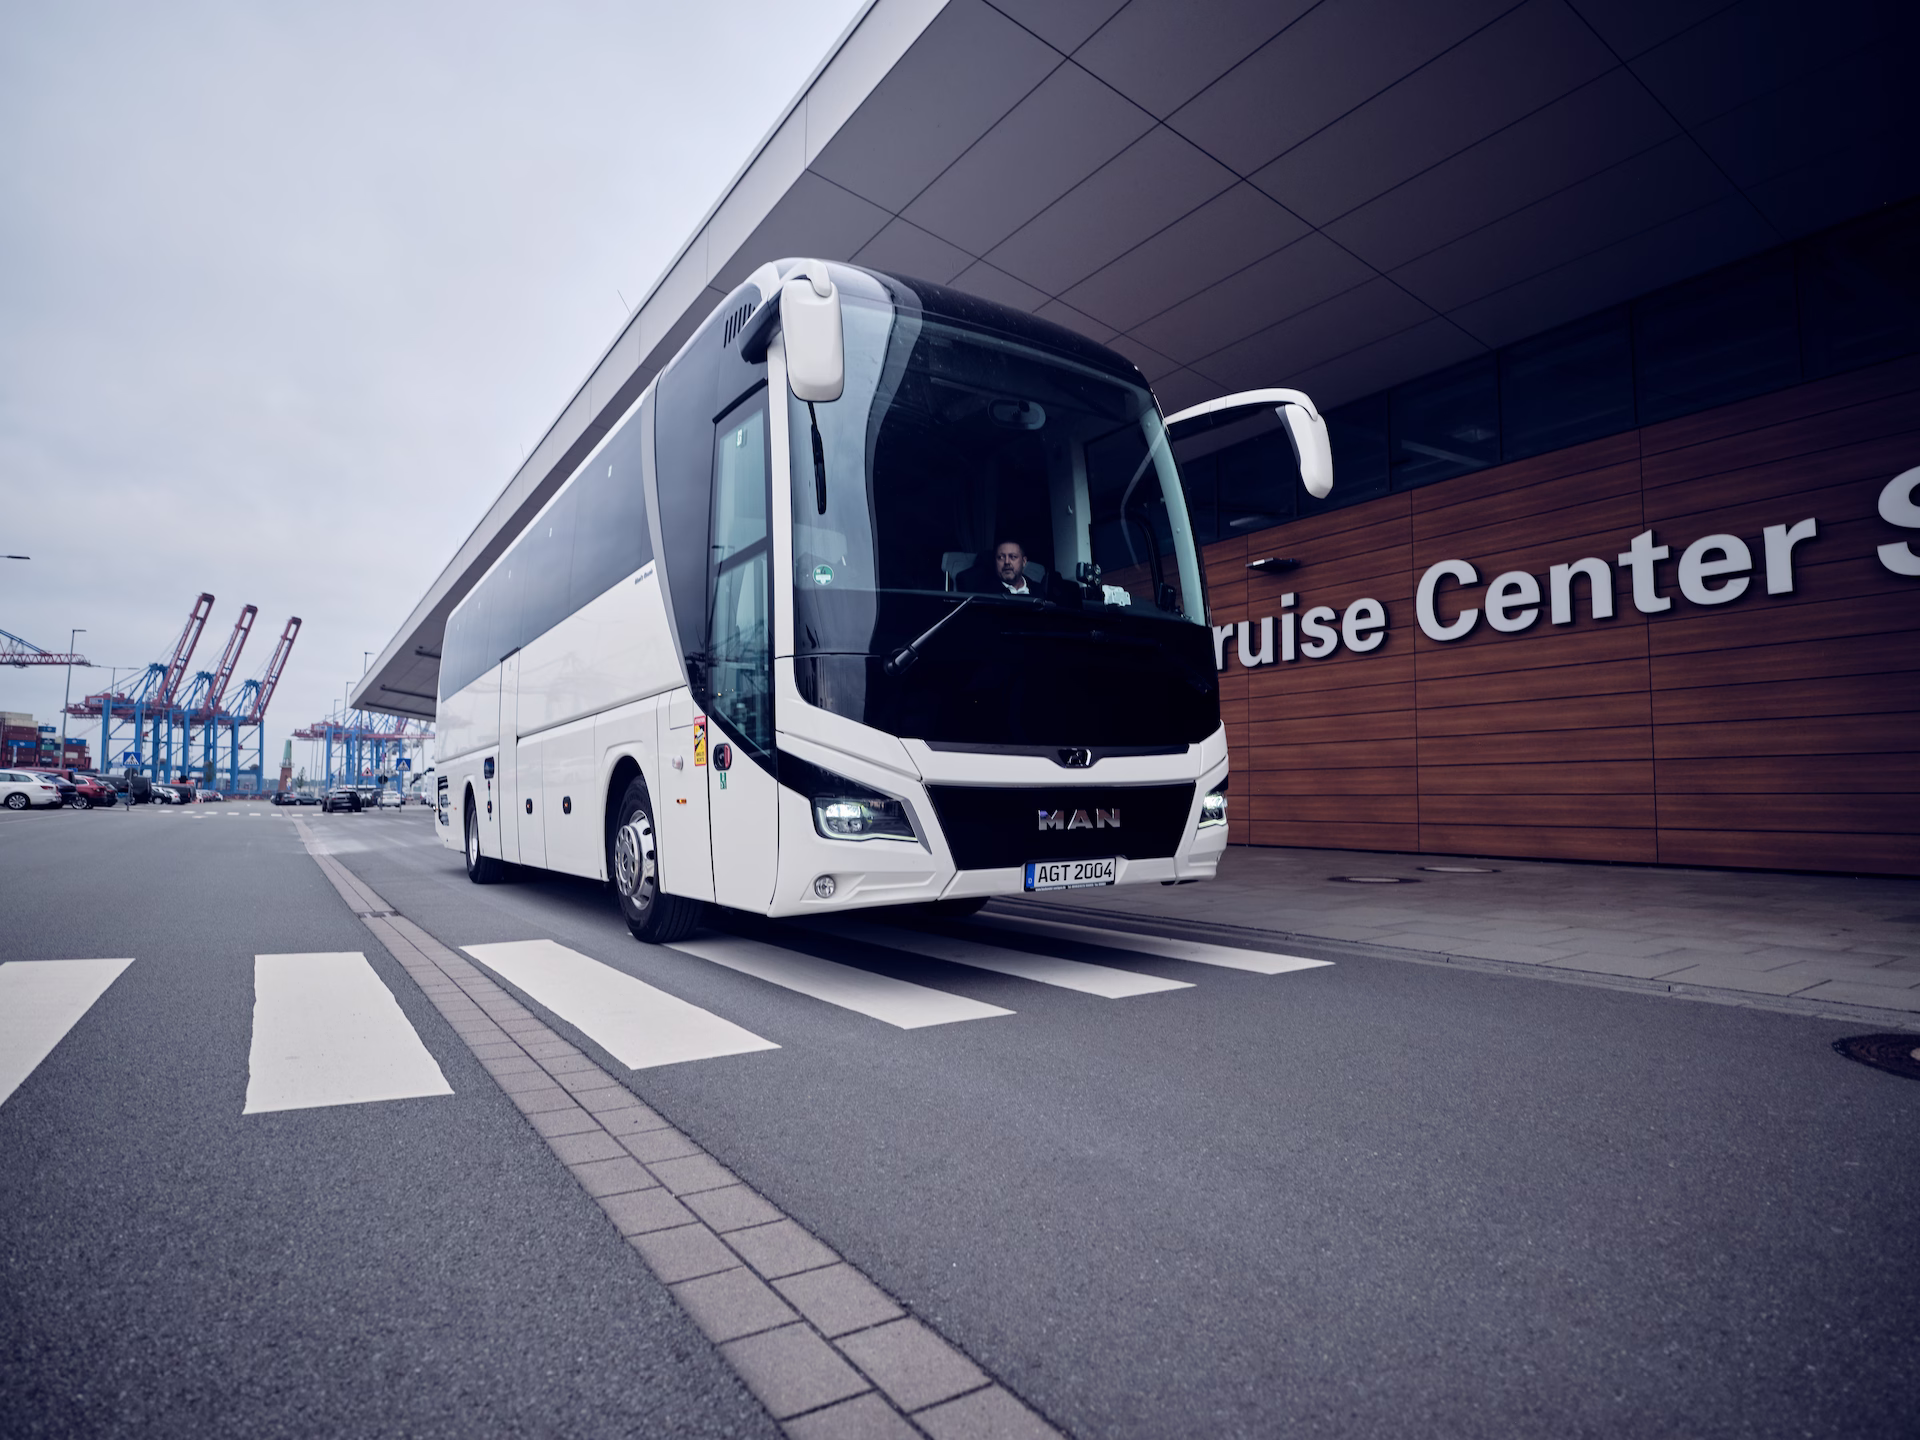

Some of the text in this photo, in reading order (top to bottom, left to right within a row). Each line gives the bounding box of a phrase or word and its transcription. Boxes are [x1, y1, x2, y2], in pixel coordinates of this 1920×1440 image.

[1416, 517, 1817, 642] Center
[1038, 808, 1121, 831] MAN
[1038, 864, 1071, 883] AGT
[1074, 861, 1113, 880] 2004
